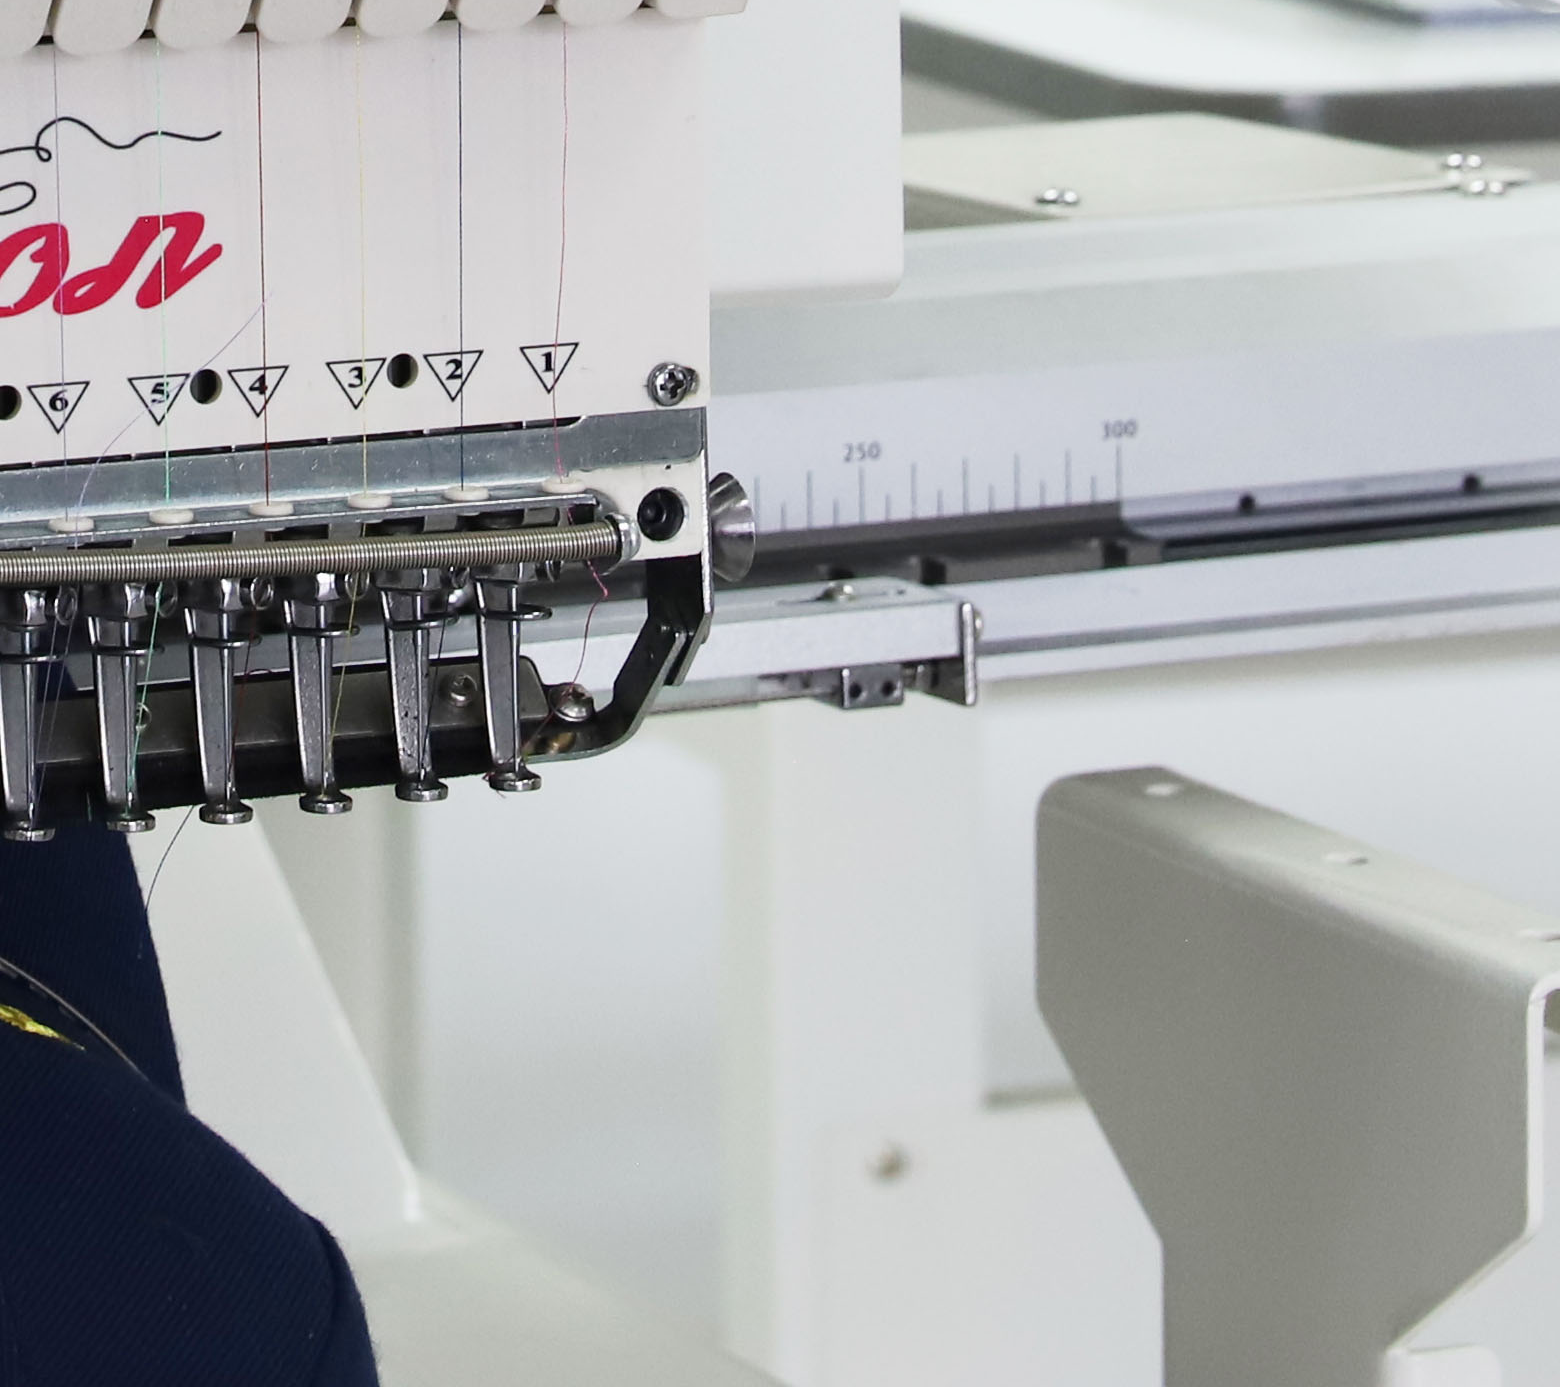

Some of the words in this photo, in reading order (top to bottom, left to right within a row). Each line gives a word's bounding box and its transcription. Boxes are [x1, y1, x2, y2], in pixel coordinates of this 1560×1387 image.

[47, 388, 70, 412] 6
[150, 381, 171, 405] 5
[247, 373, 269, 396] 4
[347, 365, 367, 389] 3
[444, 358, 464, 381] 2
[540, 350, 556, 374] 1
[842, 440, 882, 463] 250
